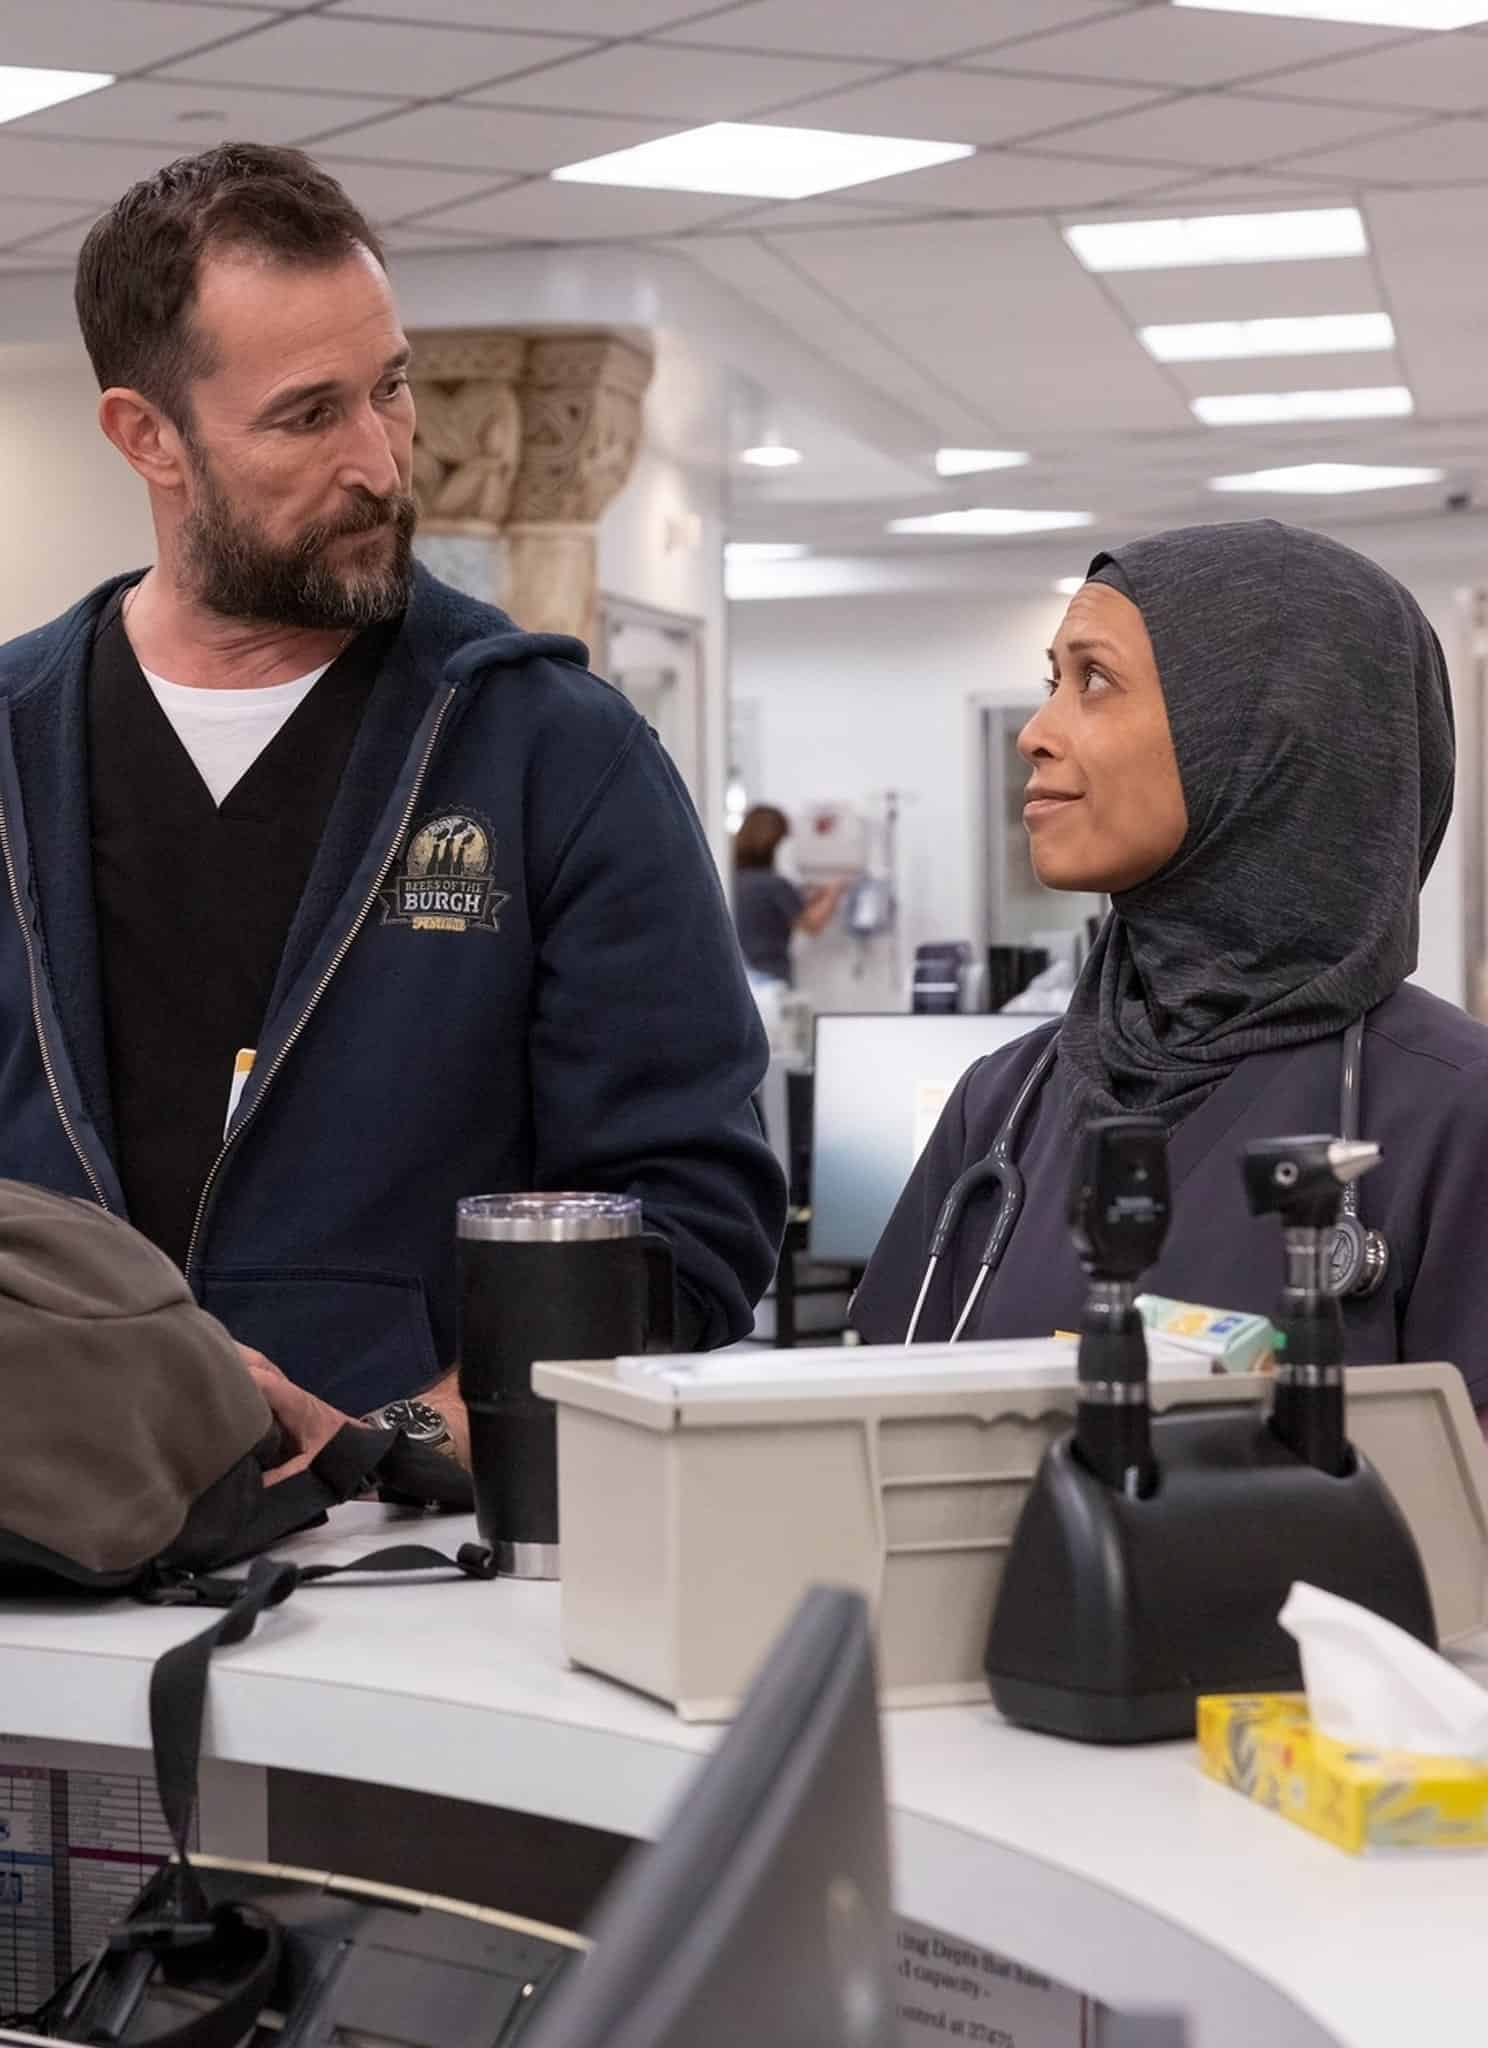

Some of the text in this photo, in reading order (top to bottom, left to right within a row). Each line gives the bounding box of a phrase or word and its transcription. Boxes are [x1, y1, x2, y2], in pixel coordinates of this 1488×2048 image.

[443, 880, 458, 891] OF
[461, 881, 482, 893] THE
[404, 892, 481, 913] BURGH
[914, 1966, 980, 1999] capacity
